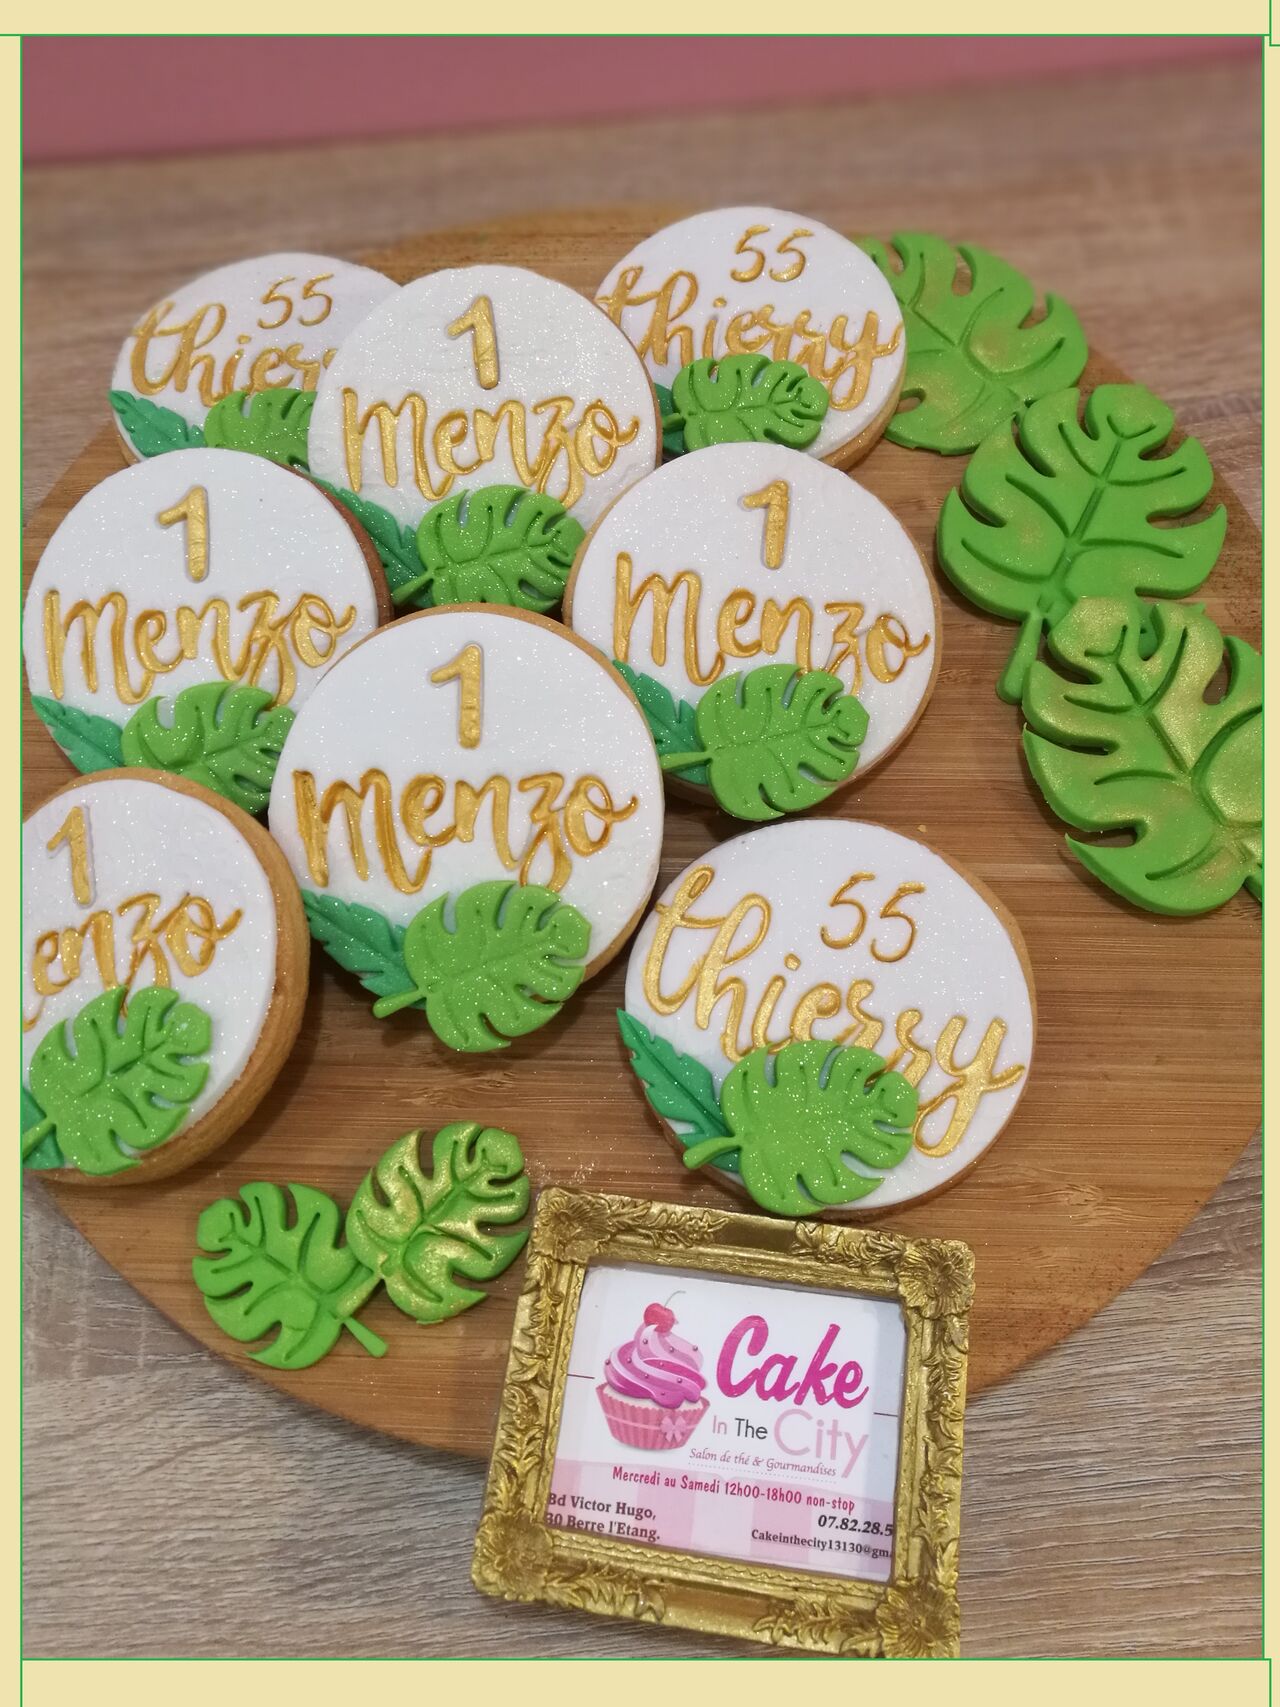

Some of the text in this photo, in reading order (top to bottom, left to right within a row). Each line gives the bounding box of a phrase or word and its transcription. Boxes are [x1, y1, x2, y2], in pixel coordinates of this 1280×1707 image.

[729, 224, 814, 283] 55
[257, 273, 335, 330] 55
[446, 295, 500, 390] 1
[158, 486, 209, 582] 1
[743, 479, 790, 570] 1
[430, 644, 483, 749] 1
[46, 805, 93, 906] 1
[820, 871, 927, 963] 55
[22, 891, 244, 1033] enzo
[716, 1315, 869, 1409] Cake
[689, 1447, 837, 1477] Salon de thé & Gourmandises
[712, 1408, 869, 1479] In The City
[570, 1495, 612, 1513] Victor
[615, 1501, 657, 1521] Hugo,
[612, 1466, 856, 1515] Mercredi au Samedi 12h00-18h00 non-stop
[817, 1514, 894, 1537] 07.82.28.5
[567, 1514, 605, 1533] Berre
[608, 1520, 661, 1543] l'Etang.
[751, 1529, 893, 1559] Cakeinthecity13130@gm
